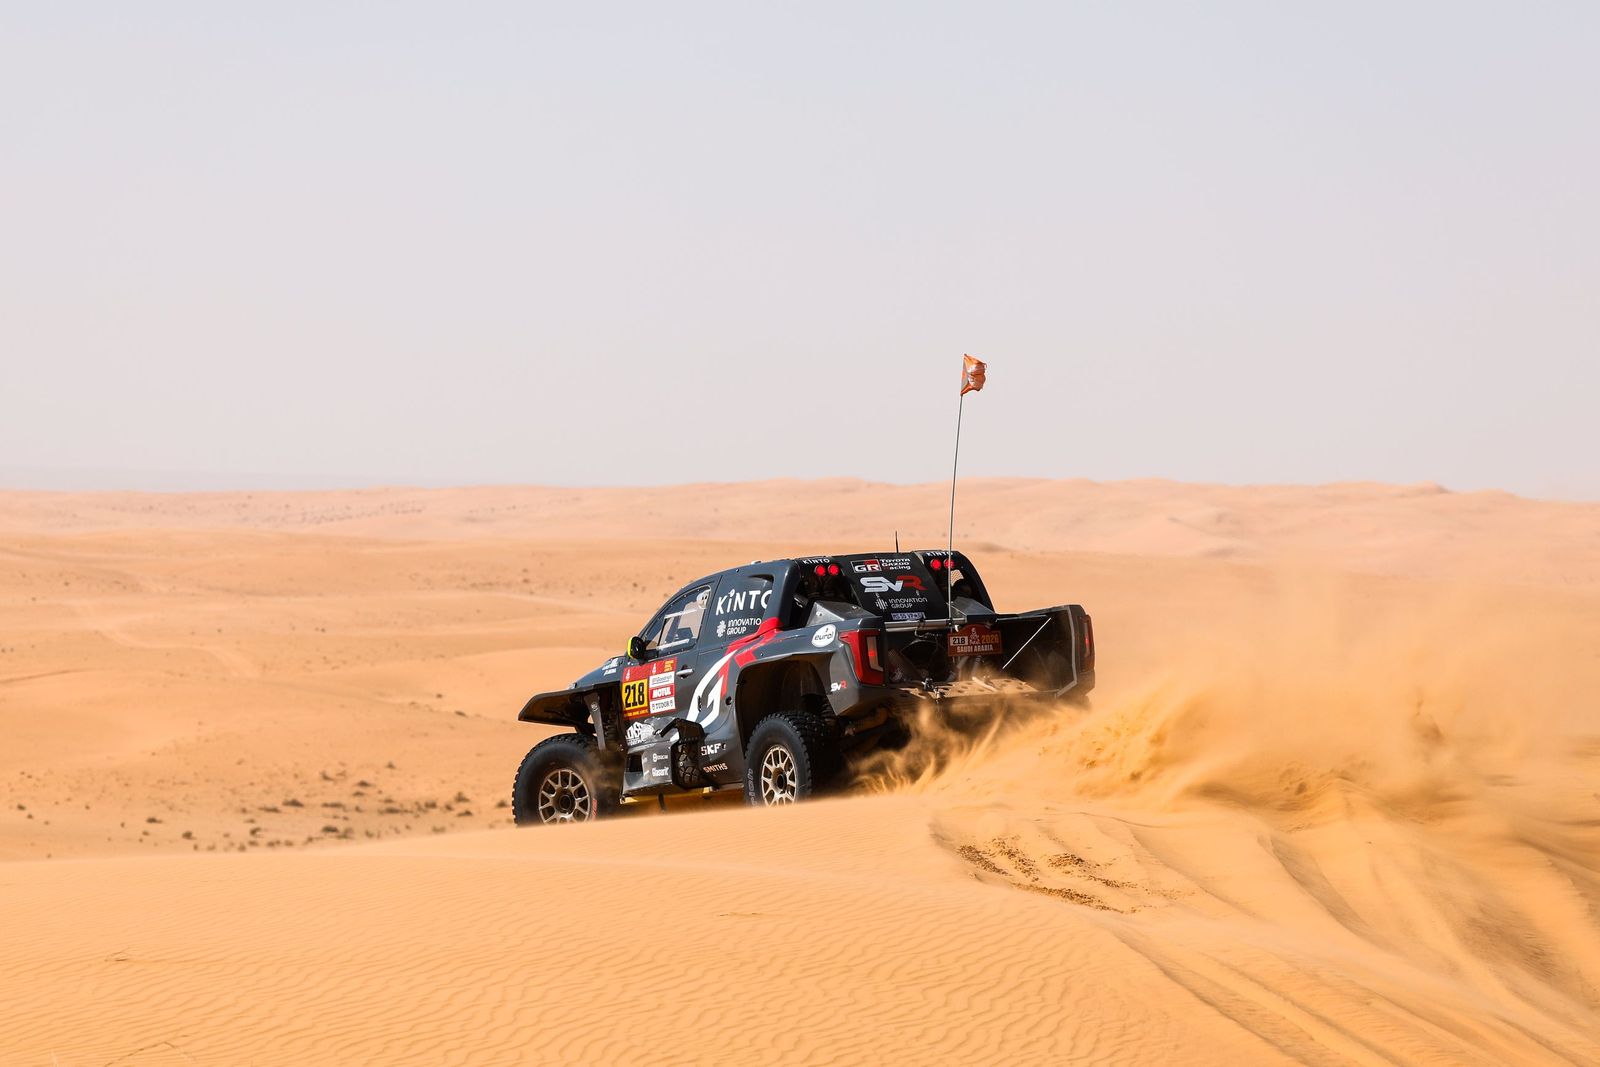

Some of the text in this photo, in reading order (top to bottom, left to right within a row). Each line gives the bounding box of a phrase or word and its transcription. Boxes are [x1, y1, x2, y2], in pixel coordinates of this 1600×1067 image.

[854, 564, 880, 572] GR
[726, 626, 747, 636] GROUP
[952, 637, 966, 645] 218
[956, 644, 993, 653] SAUDI ARABIA
[624, 682, 645, 708] 218
[700, 742, 722, 756] SKF
[703, 762, 728, 773] SMITHS
